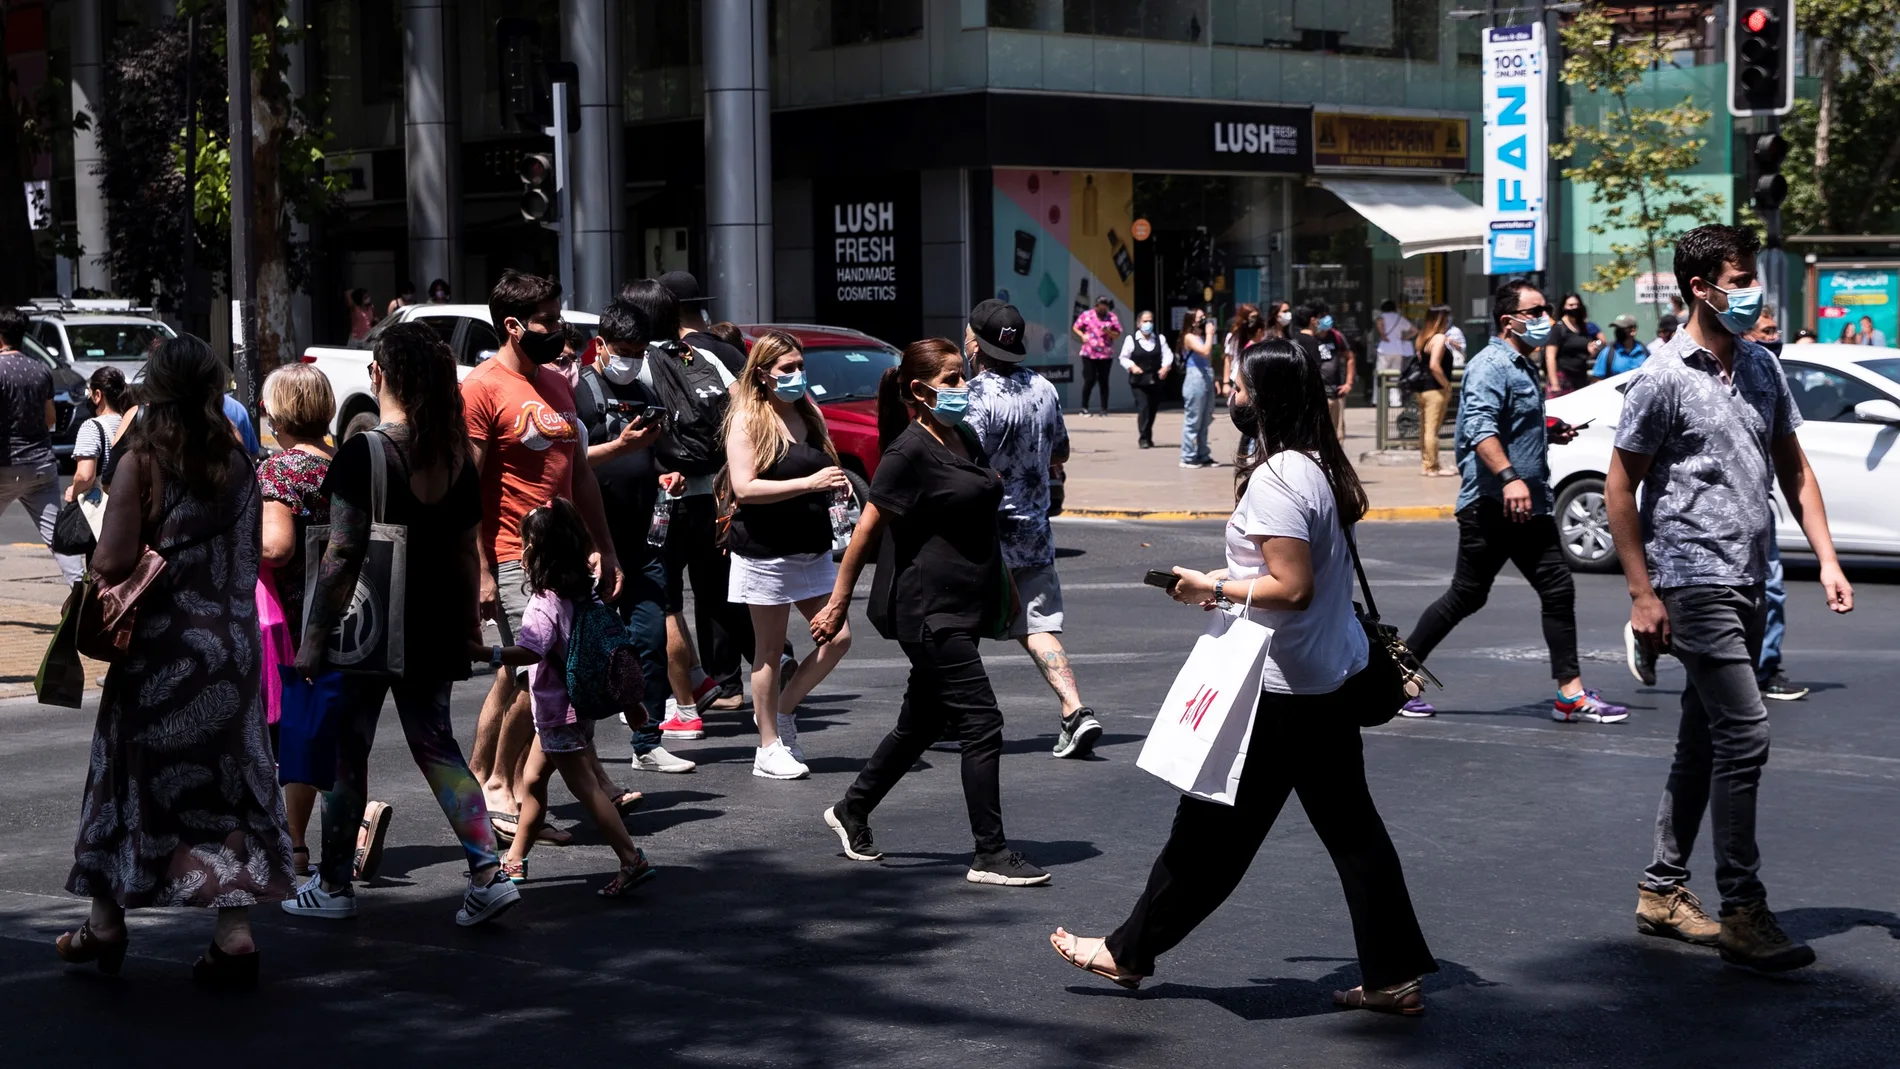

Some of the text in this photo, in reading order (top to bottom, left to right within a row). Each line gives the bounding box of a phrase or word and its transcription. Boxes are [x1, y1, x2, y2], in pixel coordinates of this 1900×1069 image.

[1214, 122, 1274, 153] LUSH
[1498, 86, 1527, 211] FAN
[835, 202, 894, 233] LUSH
[836, 237, 895, 262] FRESH
[837, 267, 896, 282] HANDMADE
[837, 286, 897, 301] COSMETICS
[1179, 684, 1219, 732] H&M
